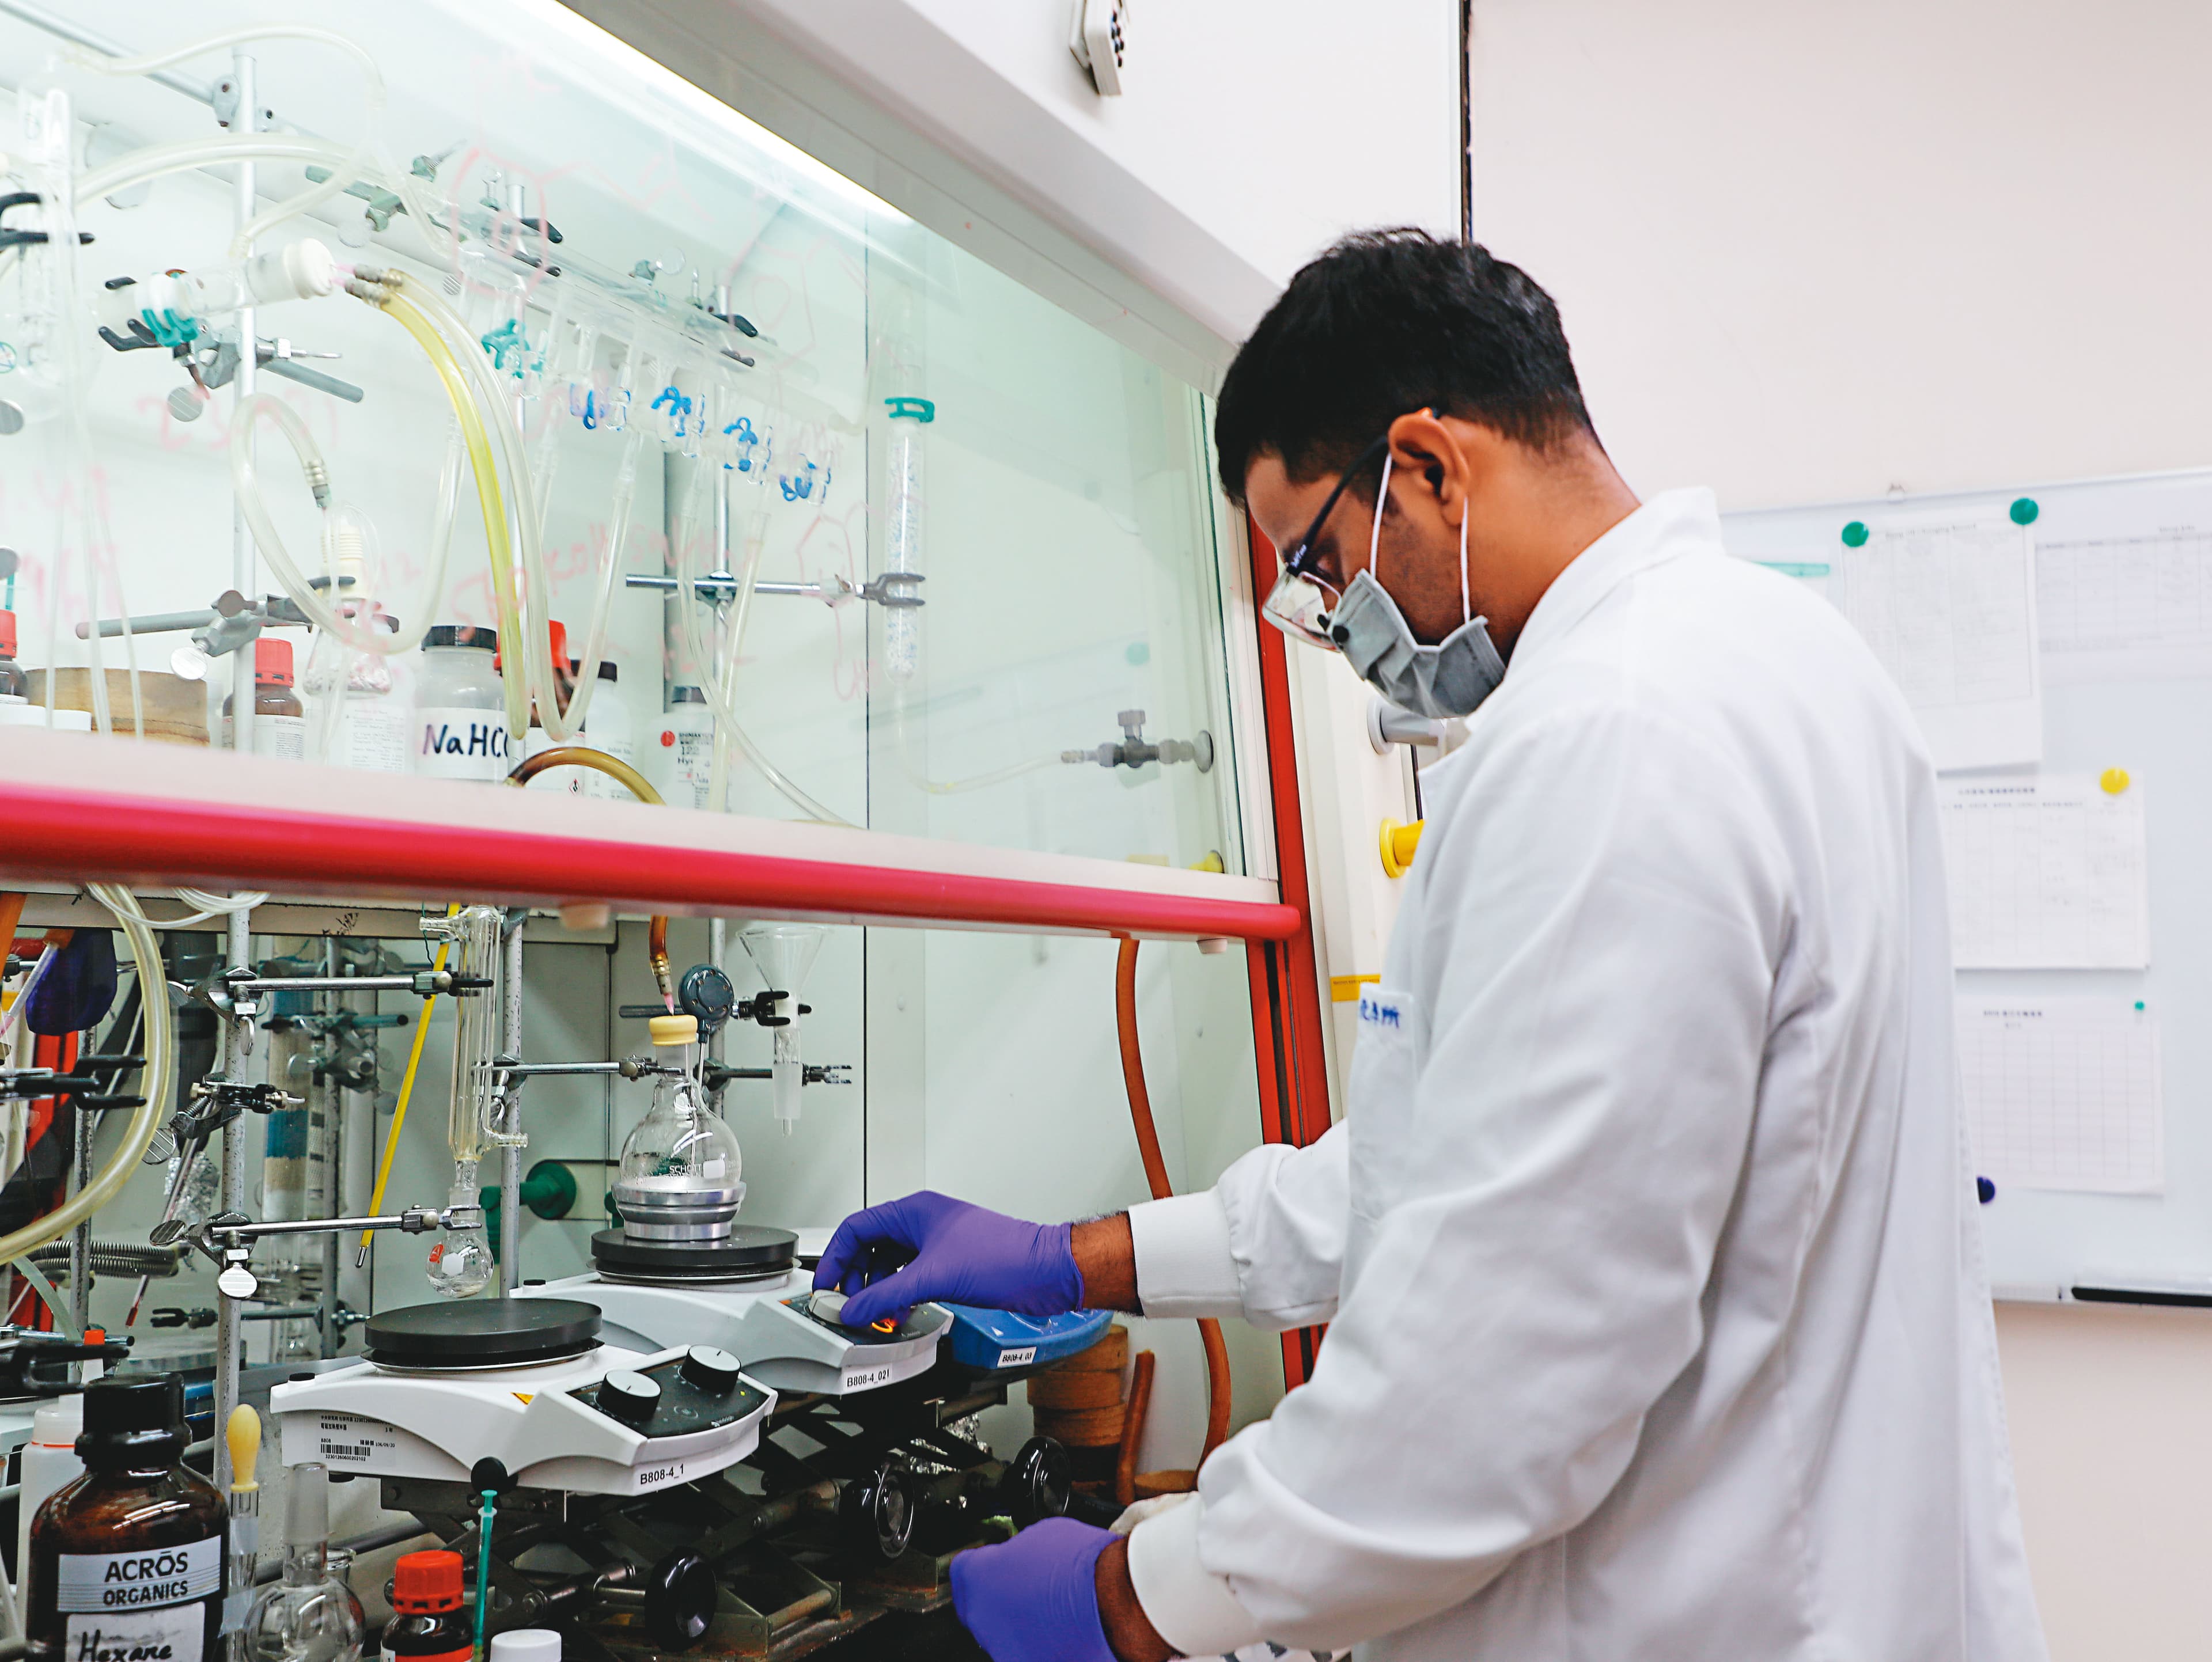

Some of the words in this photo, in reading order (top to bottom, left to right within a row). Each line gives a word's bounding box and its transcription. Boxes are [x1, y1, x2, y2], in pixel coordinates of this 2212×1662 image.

[847, 1368, 889, 1387] B808-4_021
[641, 1463, 684, 1485] B808-4_1
[103, 1580, 188, 1606] ORGANICS
[78, 1629, 172, 1662] Hexane
